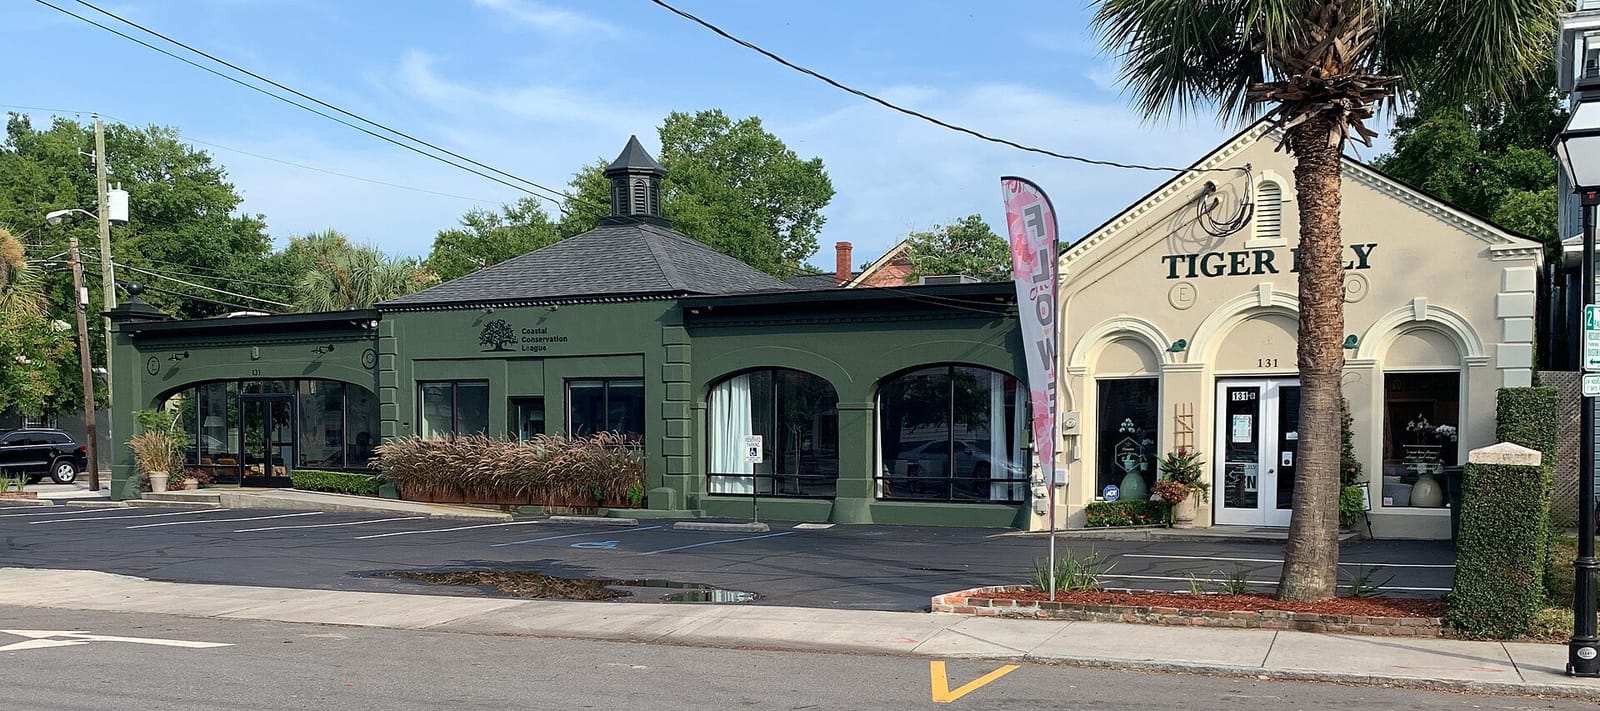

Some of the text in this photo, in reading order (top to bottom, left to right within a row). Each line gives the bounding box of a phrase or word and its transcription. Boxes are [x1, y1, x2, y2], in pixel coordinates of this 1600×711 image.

[1161, 249, 1279, 279] TIGER
[521, 327, 547, 335] Coastal
[521, 335, 568, 343] Conservation
[521, 344, 547, 352] League
[1258, 358, 1278, 368] 131
[251, 368, 261, 376] 131
